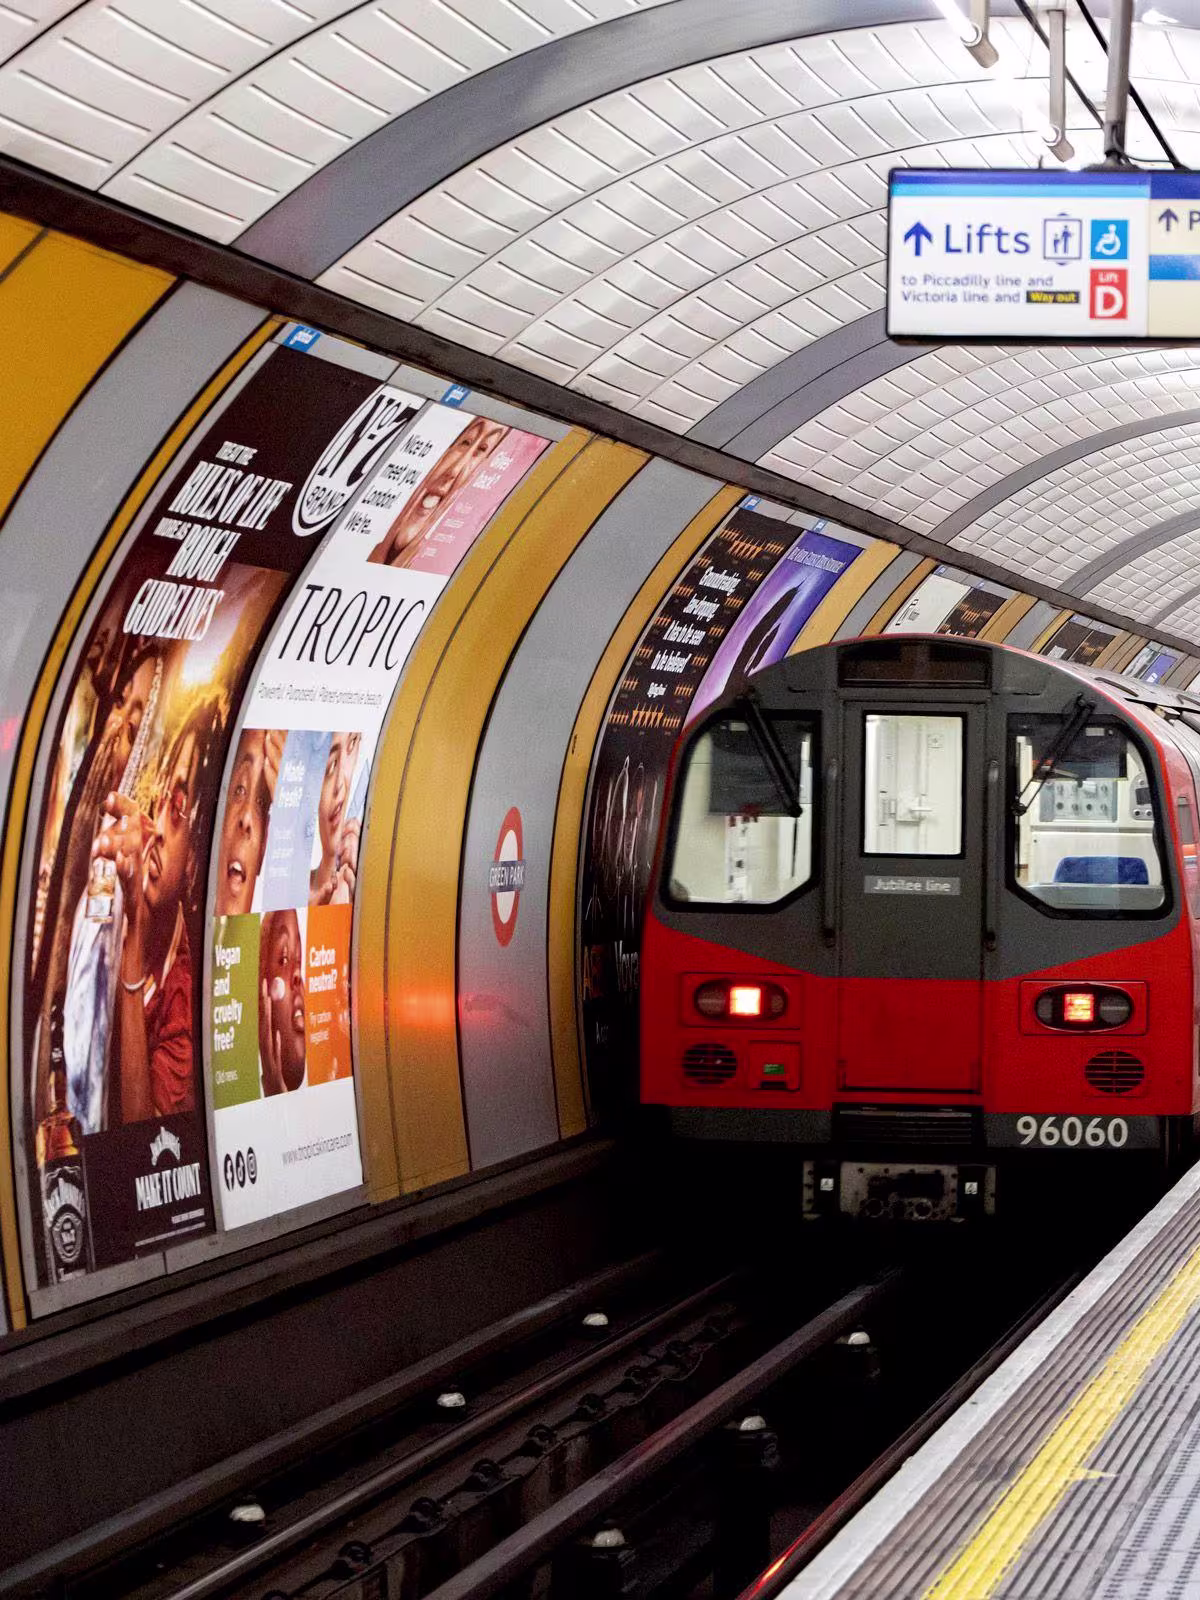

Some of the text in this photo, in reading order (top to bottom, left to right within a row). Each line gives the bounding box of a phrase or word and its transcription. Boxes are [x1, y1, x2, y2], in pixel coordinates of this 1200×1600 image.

[944, 223, 1030, 254] Lifts
[902, 274, 1053, 288] to Piccadilly line and
[1099, 271, 1118, 283] Lift
[902, 291, 1076, 304] Victoria line and Way out
[1096, 286, 1123, 317] D
[168, 460, 294, 530] RULES OF LIFE
[165, 523, 242, 583] ROUGH
[123, 578, 225, 641] GUIDELINES
[278, 584, 425, 671] TROPIC
[489, 865, 525, 887] GREEN PARK
[873, 878, 951, 892] Jubilee line
[215, 945, 241, 970] Vegan
[309, 944, 336, 967] Carbon
[213, 972, 230, 997] and
[309, 968, 338, 993] neutral?
[213, 998, 243, 1025] cruelty
[213, 1025, 235, 1052] free?
[1016, 1115, 1129, 1148] 96060
[134, 1173, 164, 1211] MAKE
[160, 1168, 172, 1204] IT
